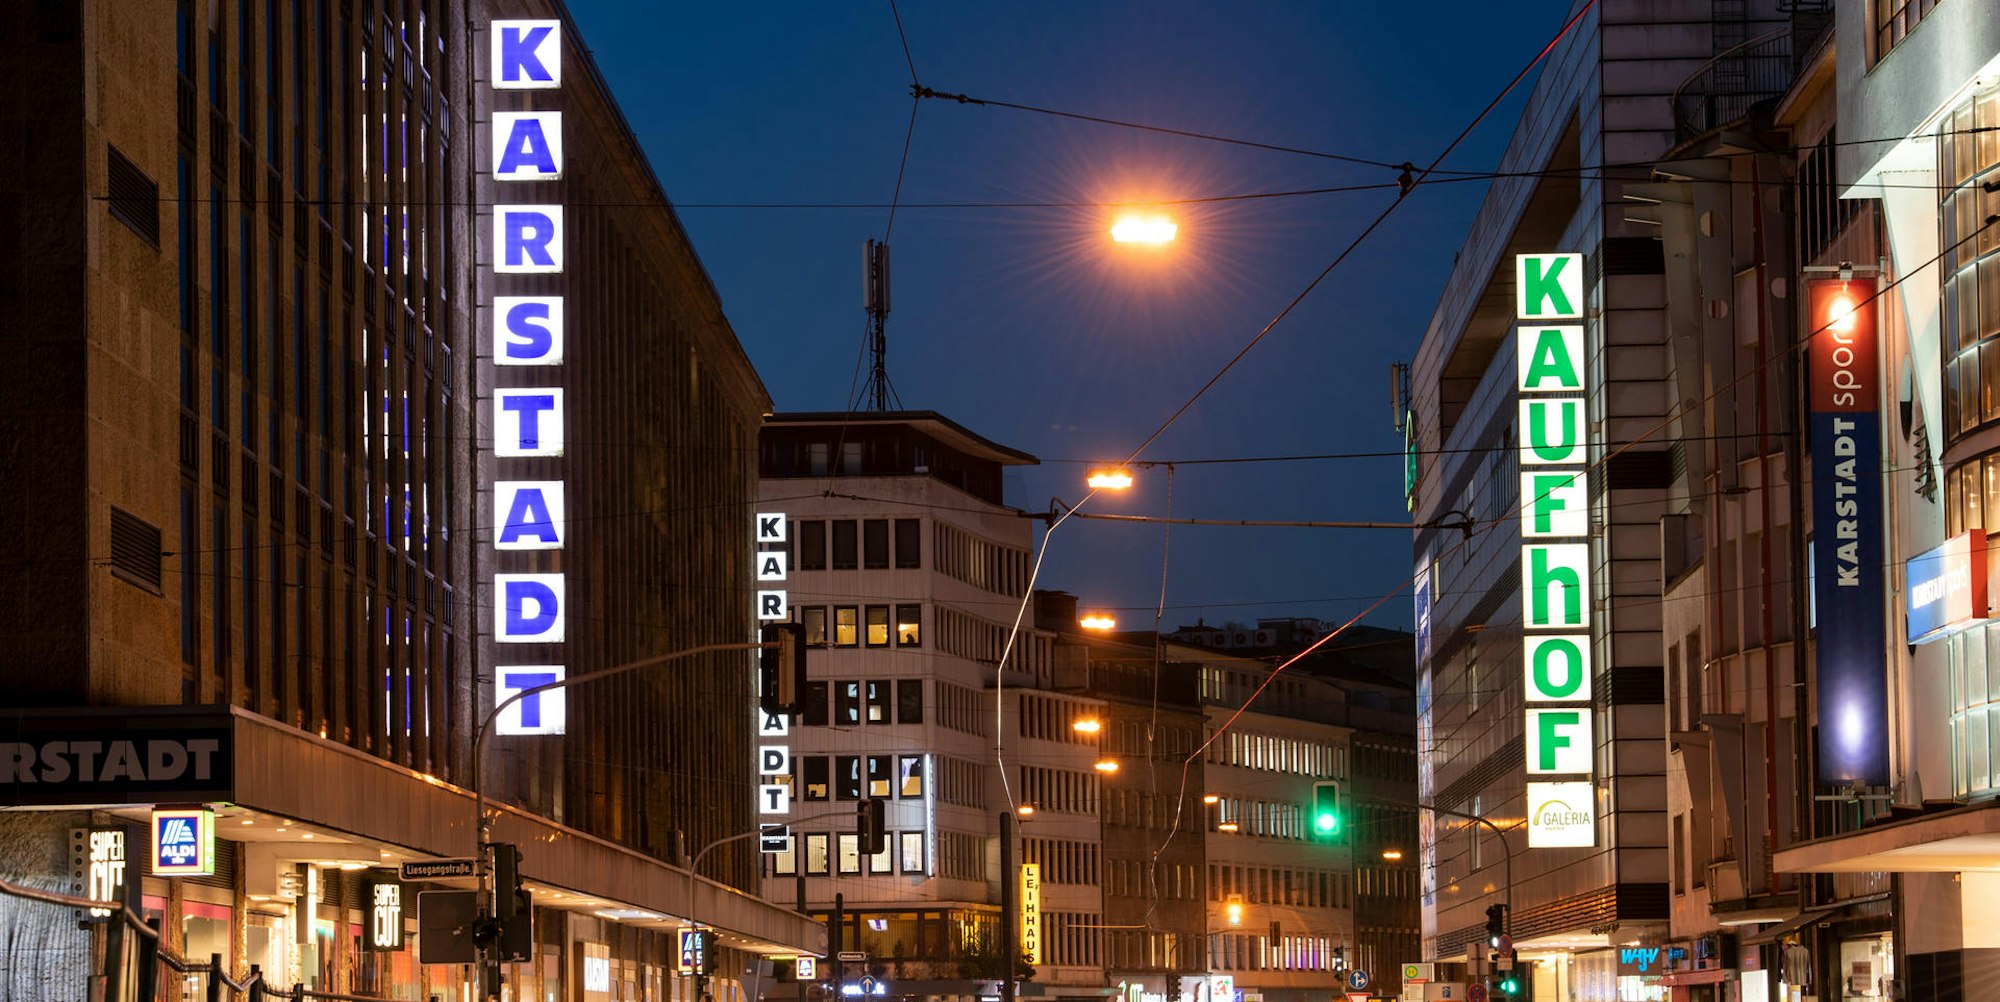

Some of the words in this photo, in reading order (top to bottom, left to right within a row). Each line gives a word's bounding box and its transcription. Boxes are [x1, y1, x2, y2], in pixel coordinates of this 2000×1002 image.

[497, 26, 559, 728] KARSTADT
[1834, 418, 1859, 586] KARSTADT
[761, 516, 784, 810] KARADT
[1543, 811, 1591, 826] GALERIA
[89, 831, 125, 861] SUPER
[160, 845, 196, 858] ALDI
[374, 883, 400, 906] SUPER
[1026, 867, 1035, 963] LEIHHAUS
[374, 905, 401, 947] CUT
